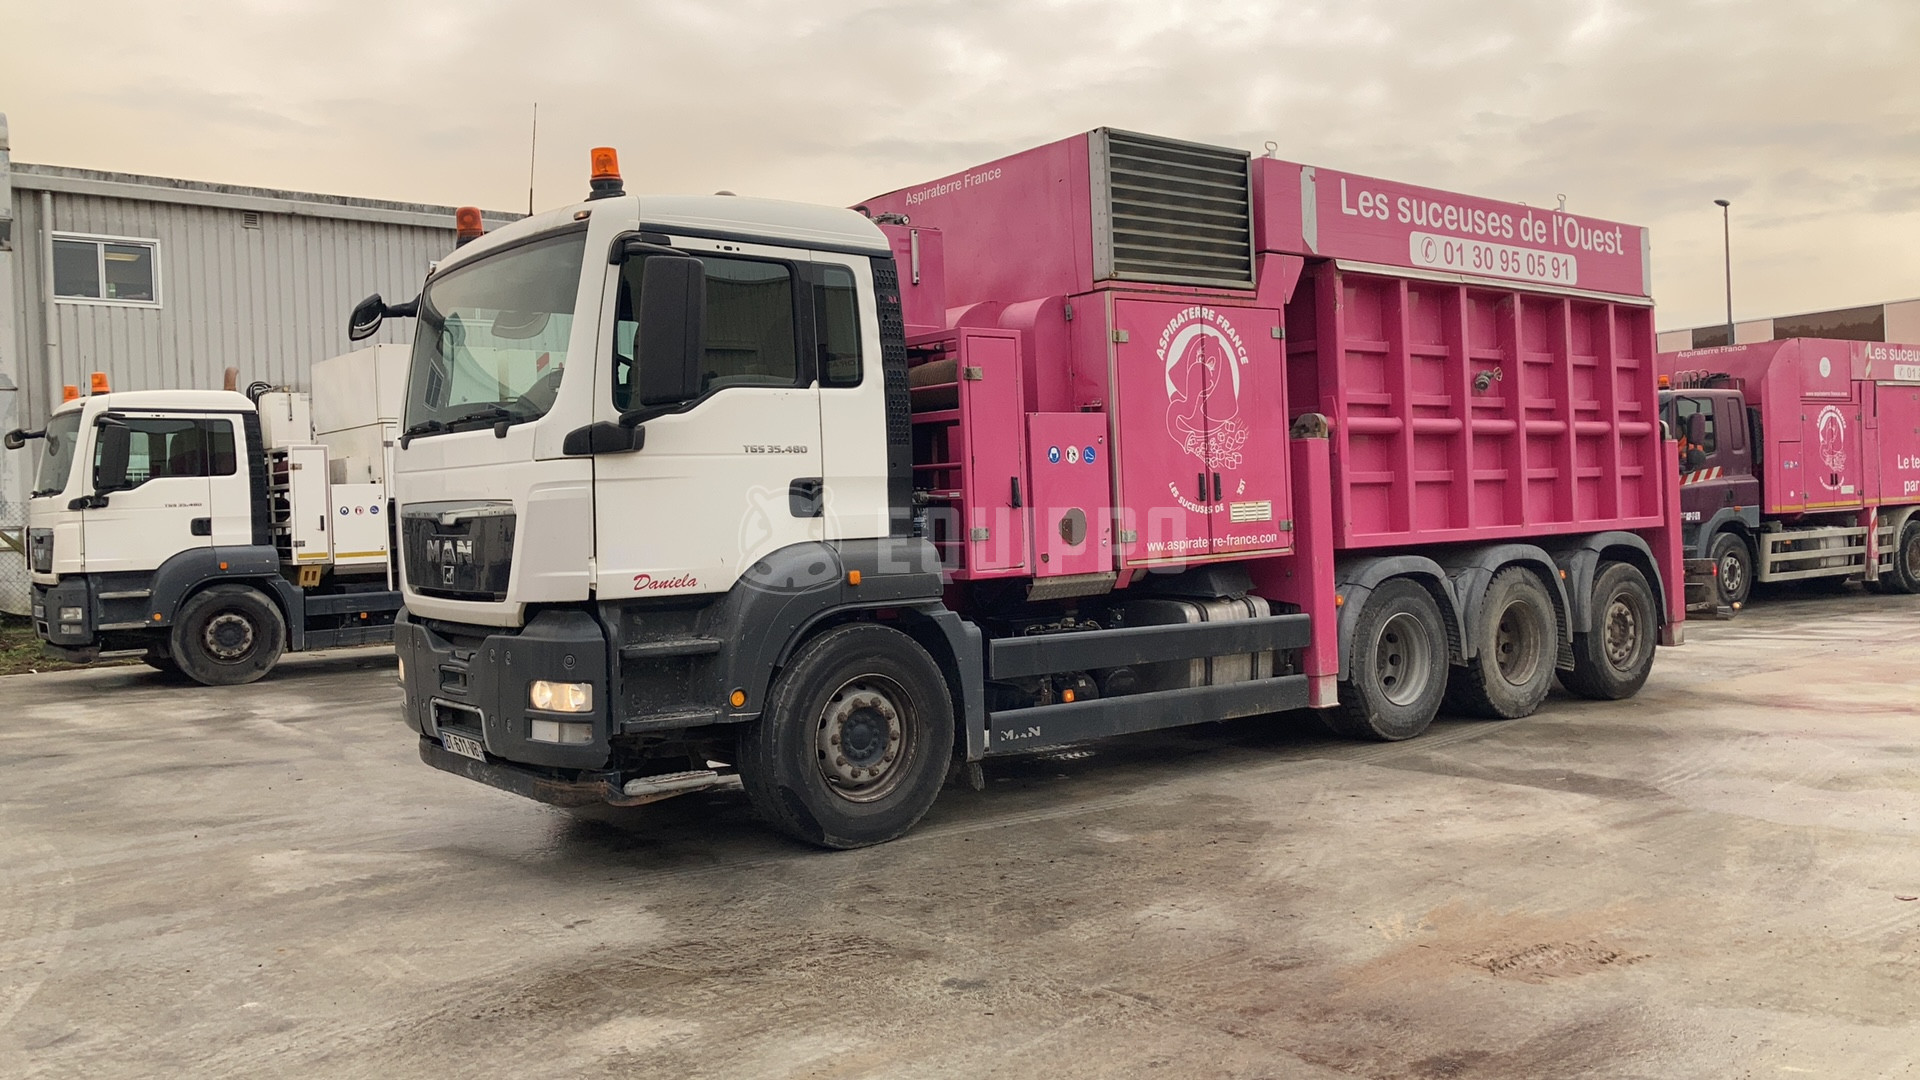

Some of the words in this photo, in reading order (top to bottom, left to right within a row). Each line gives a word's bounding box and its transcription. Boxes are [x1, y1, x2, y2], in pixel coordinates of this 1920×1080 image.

[905, 180, 962, 206] Aspiraterre
[964, 168, 1001, 188] France
[1340, 178, 1389, 220] Les
[1397, 197, 1513, 239] suceuses
[1519, 210, 1547, 243] de
[1552, 214, 1624, 255] l'Ouest
[1444, 240, 1464, 266] 01
[1472, 245, 1493, 270] 30
[1500, 249, 1520, 274] 95
[1526, 252, 1546, 277] 05
[1551, 255, 1569, 280] 91
[1156, 306, 1215, 361] ASPIRATERRE
[1216, 314, 1249, 365] FRANCE
[1869, 347, 1888, 360] Les
[1889, 348, 1920, 362] suceu
[743, 445, 765, 454] TGS
[767, 445, 808, 454] 35.480
[1897, 454, 1910, 469] Le
[1168, 481, 1179, 498] LES
[1178, 496, 1213, 515] SUCEUSES
[1214, 503, 1225, 513] DE
[1904, 480, 1920, 496] par
[427, 540, 472, 564] MAN
[633, 573, 697, 591] Daniela
